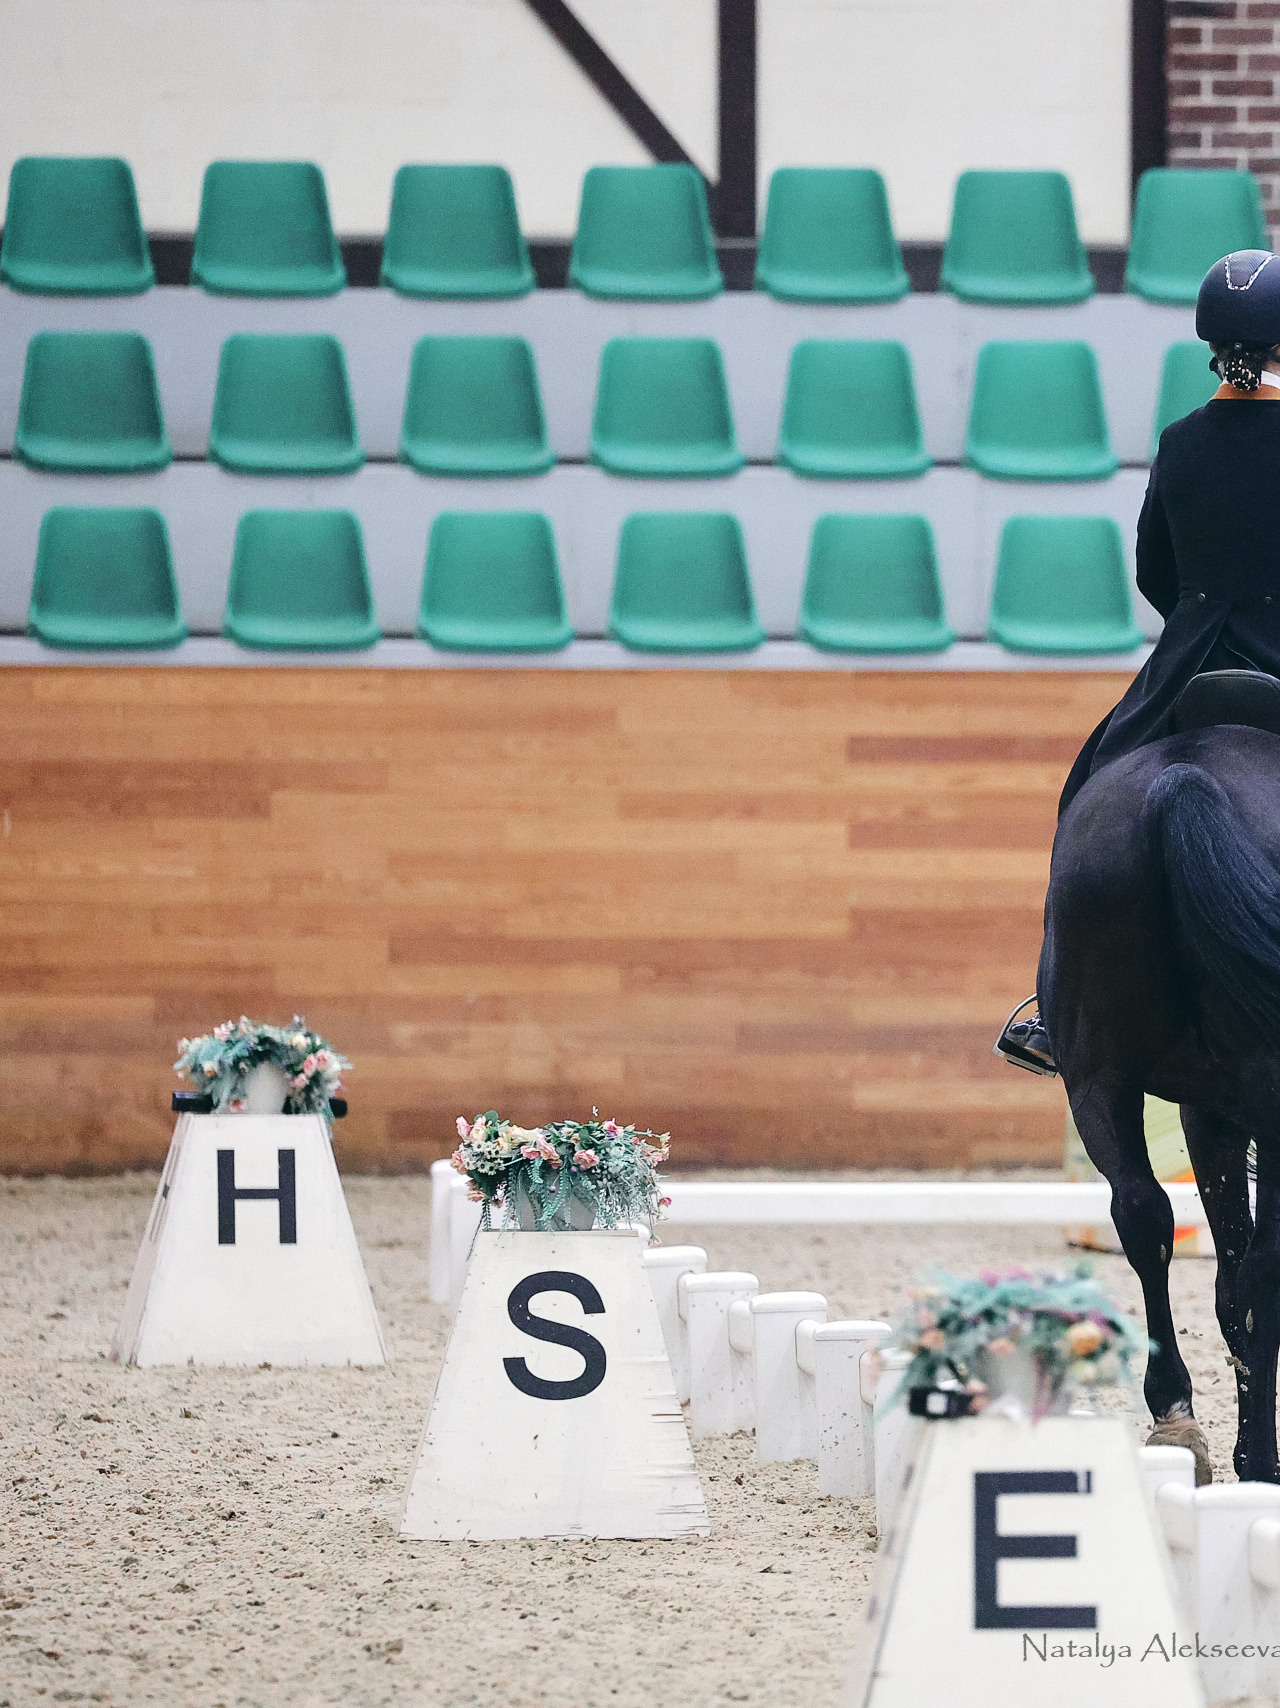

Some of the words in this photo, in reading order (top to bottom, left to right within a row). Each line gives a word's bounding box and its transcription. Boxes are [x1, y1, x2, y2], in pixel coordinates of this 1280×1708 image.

[216, 1148, 297, 1245] H
[502, 1270, 607, 1401] S
[973, 1470, 1098, 1630] E
